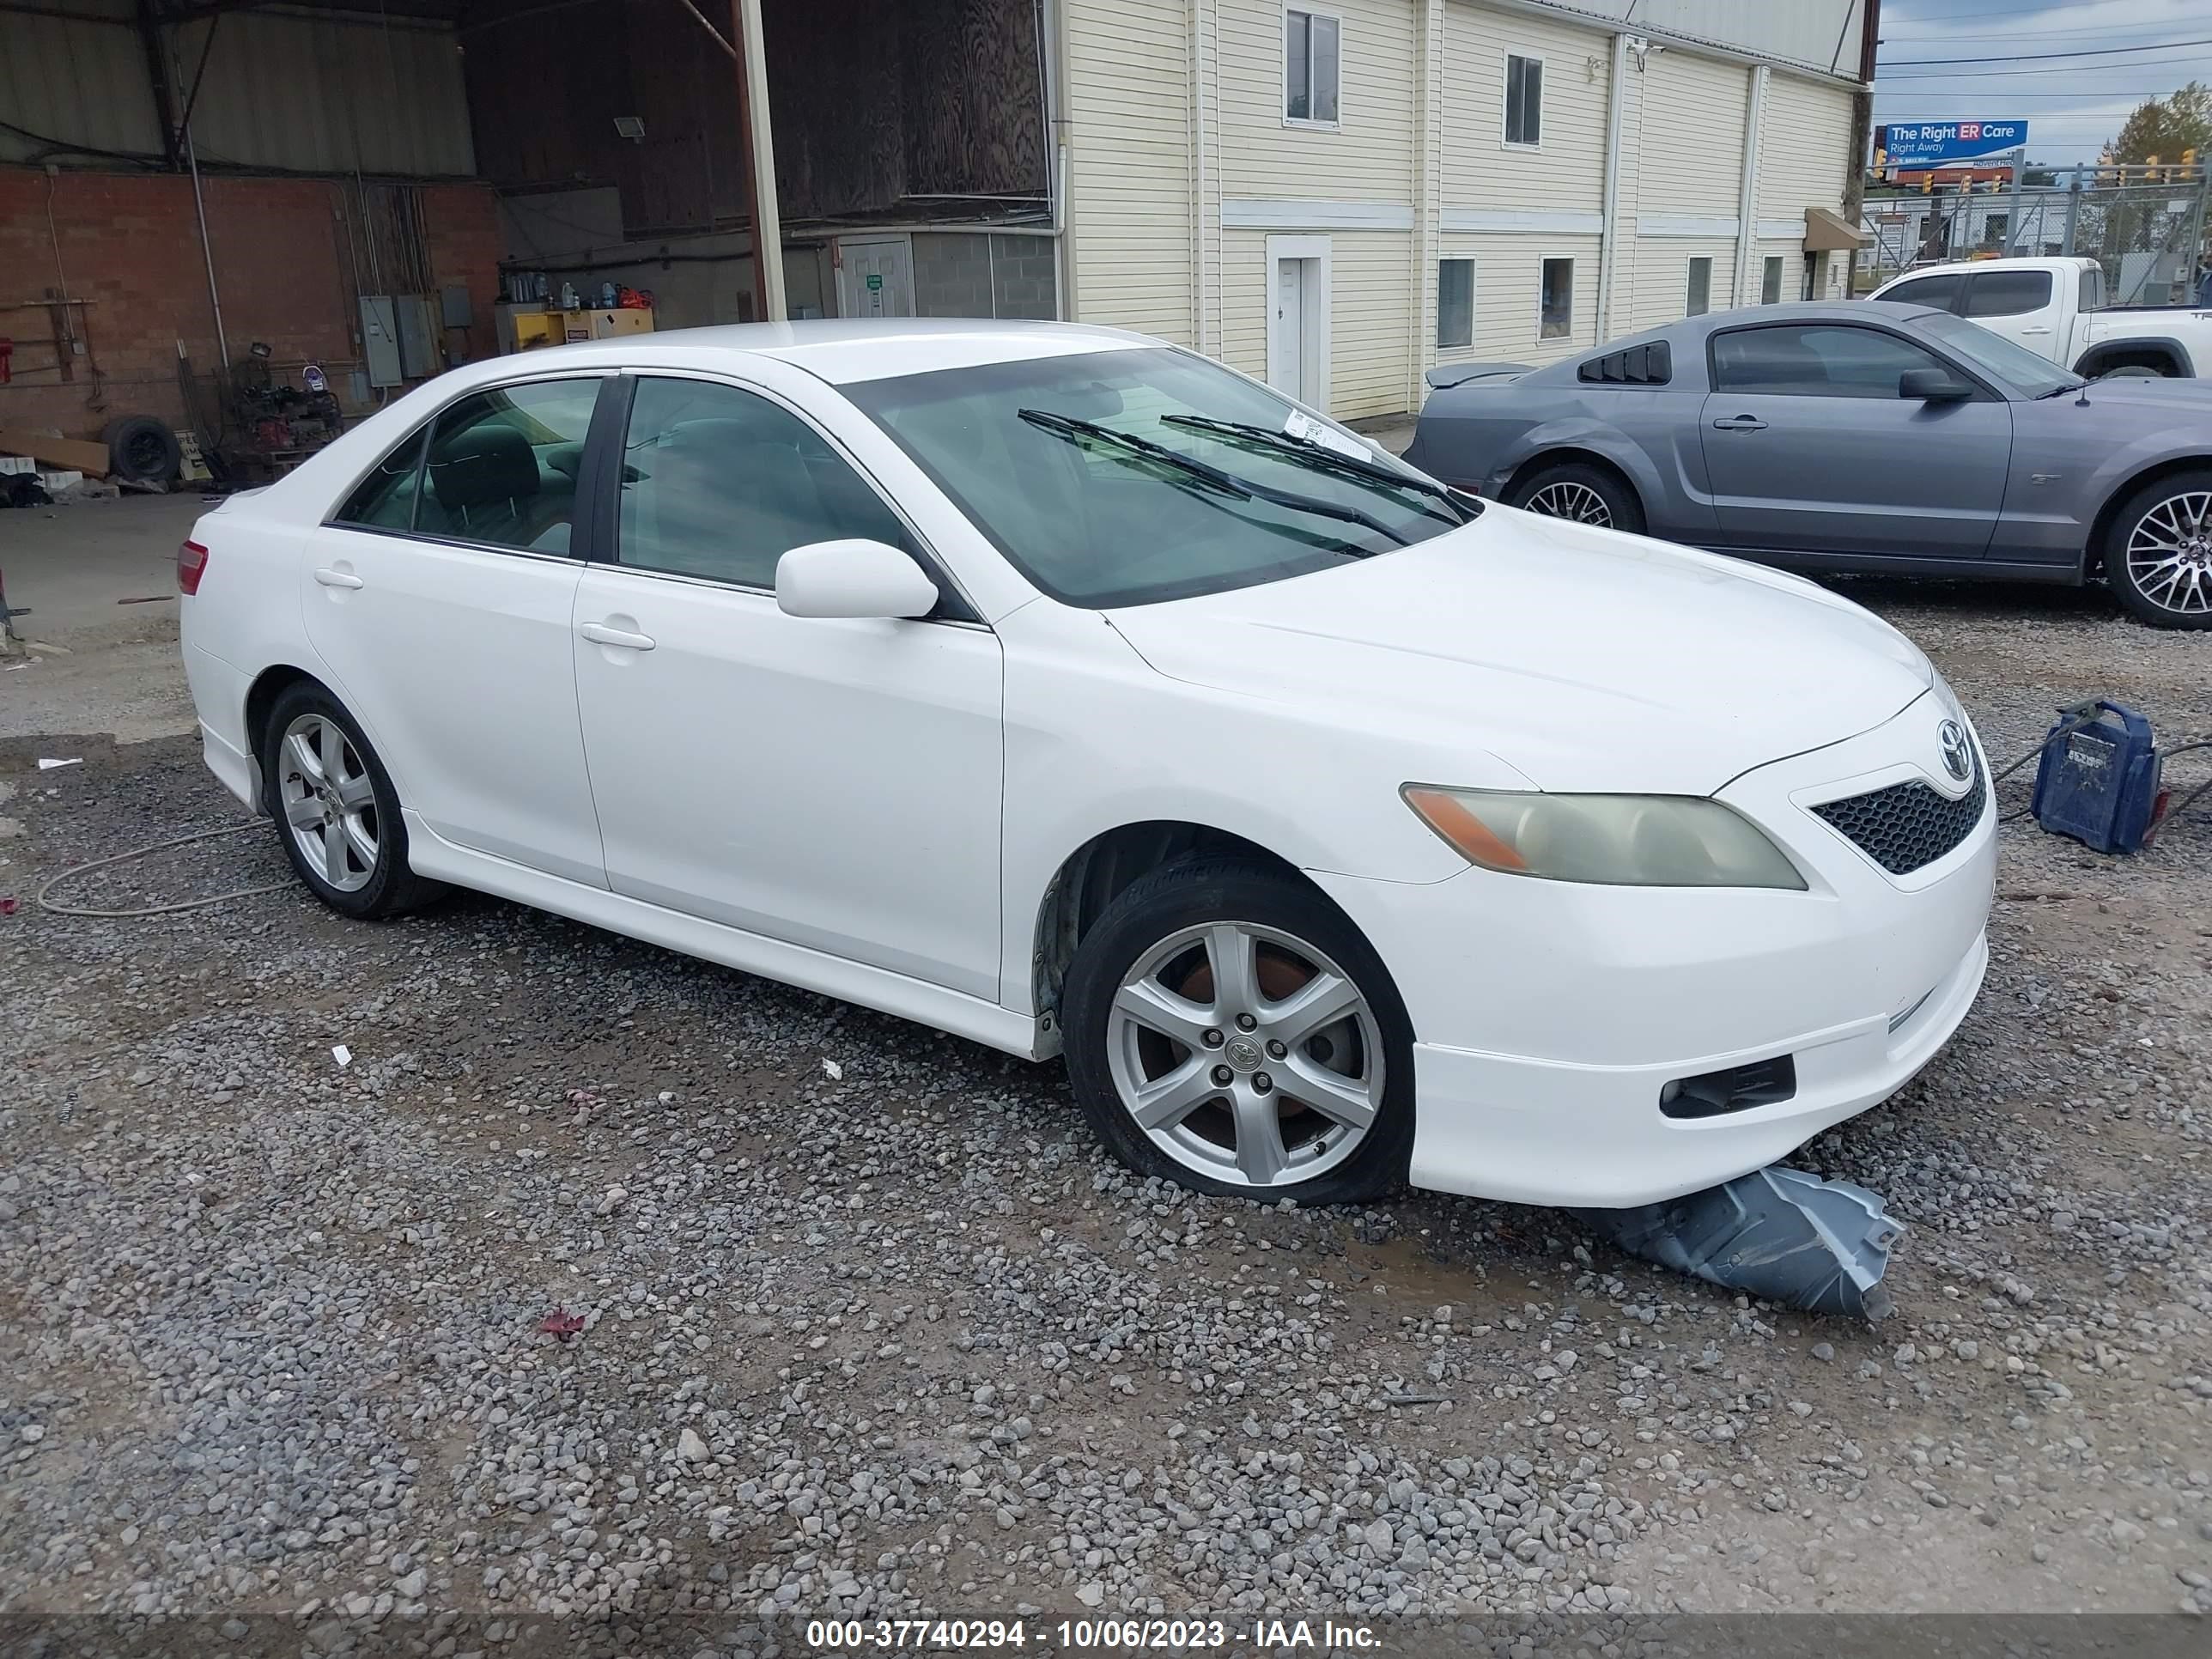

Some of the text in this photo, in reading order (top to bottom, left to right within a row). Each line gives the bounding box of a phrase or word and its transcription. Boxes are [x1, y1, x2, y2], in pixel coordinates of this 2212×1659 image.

[1892, 125, 2014, 142] The Right ER Care
[1890, 143, 1945, 155] Right Away
